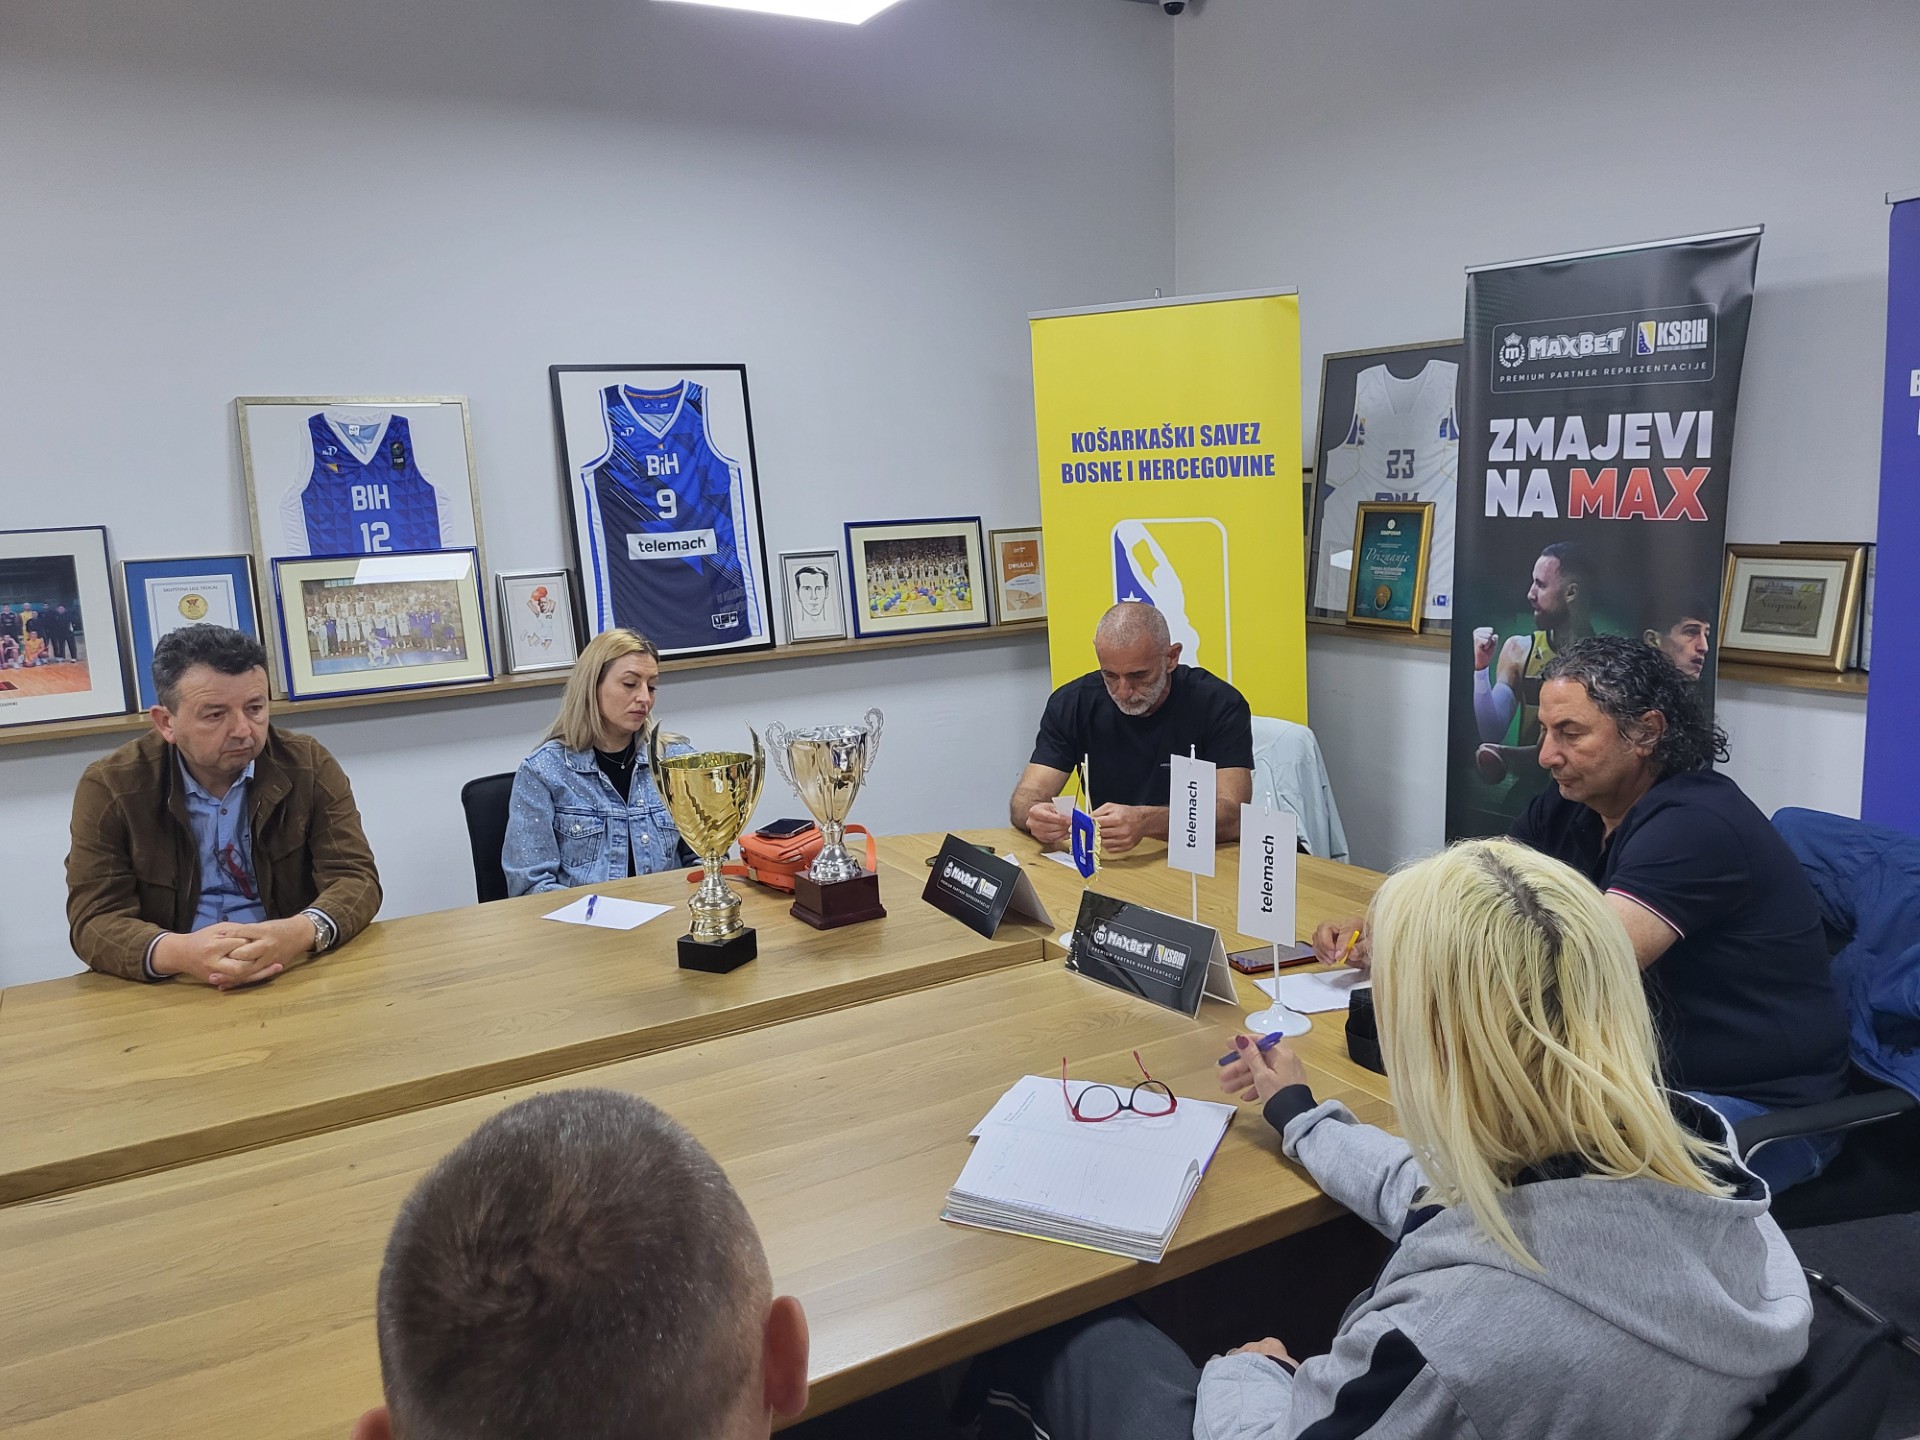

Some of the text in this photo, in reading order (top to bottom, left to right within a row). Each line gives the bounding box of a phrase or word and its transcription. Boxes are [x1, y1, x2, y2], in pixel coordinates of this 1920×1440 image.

[1657, 318, 1708, 346] KSBIH
[1500, 362, 1707, 382] PREMIUM PARTNER REPREZENTACIJE
[1071, 422, 1260, 453] KOŠARKAŠKI SAVEZ
[1488, 410, 1713, 461] ZMAJEVI
[646, 453, 680, 476] BiH
[1061, 454, 1275, 484] BOSNE I HERCEGOVINE
[1386, 449, 1415, 478] 23
[351, 484, 390, 511] BIH
[656, 488, 678, 519] 9
[1485, 467, 1711, 521] NA MAX
[360, 521, 392, 552] 12
[638, 536, 707, 552] telemach
[1186, 781, 1197, 848] telemach
[1261, 835, 1274, 912] telemach
[1114, 954, 1136, 966] PARTNER
[1163, 947, 1186, 967] KSBIH
